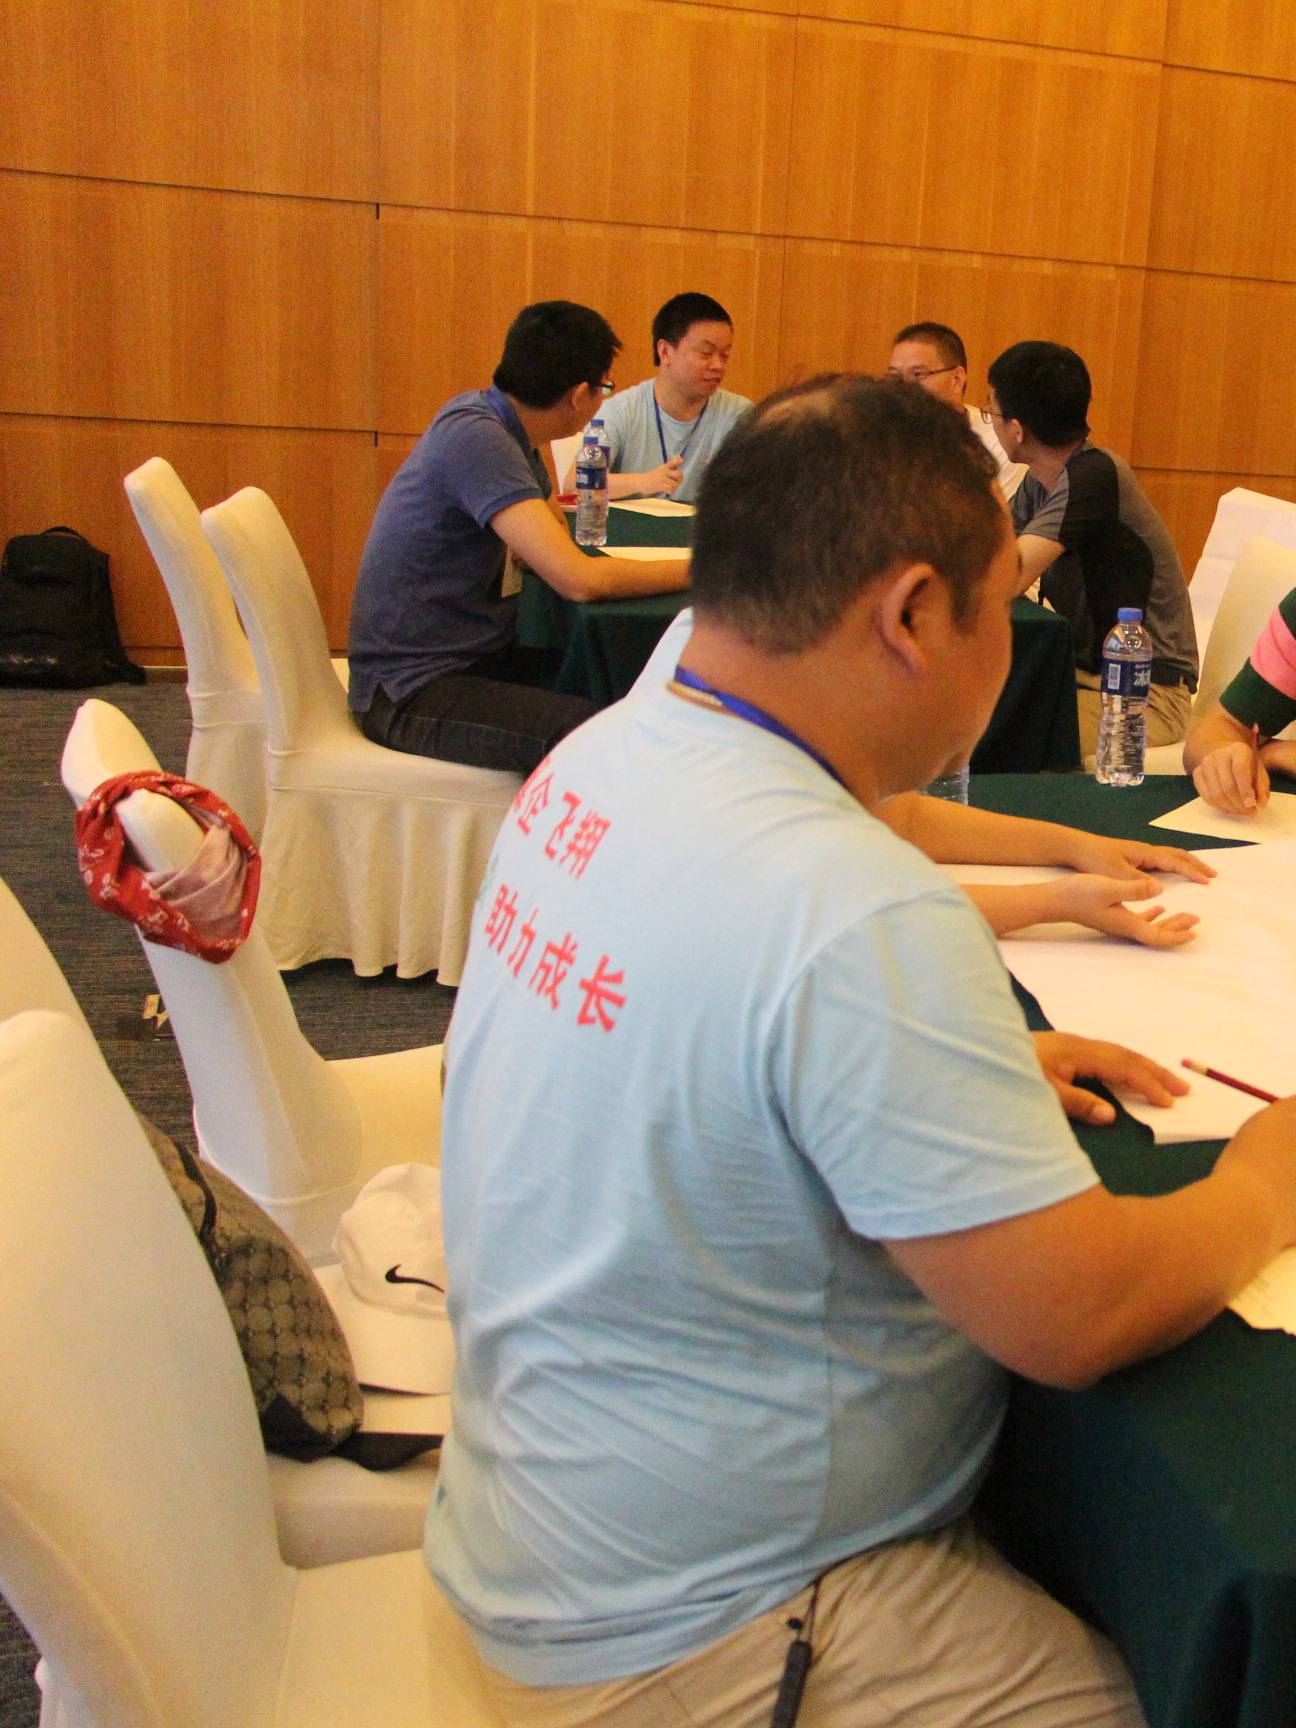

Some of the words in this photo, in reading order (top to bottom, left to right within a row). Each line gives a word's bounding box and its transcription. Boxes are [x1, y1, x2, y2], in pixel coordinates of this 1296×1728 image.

[513, 753, 612, 880] 企飞翔
[484, 883, 627, 1032] 助力成长
